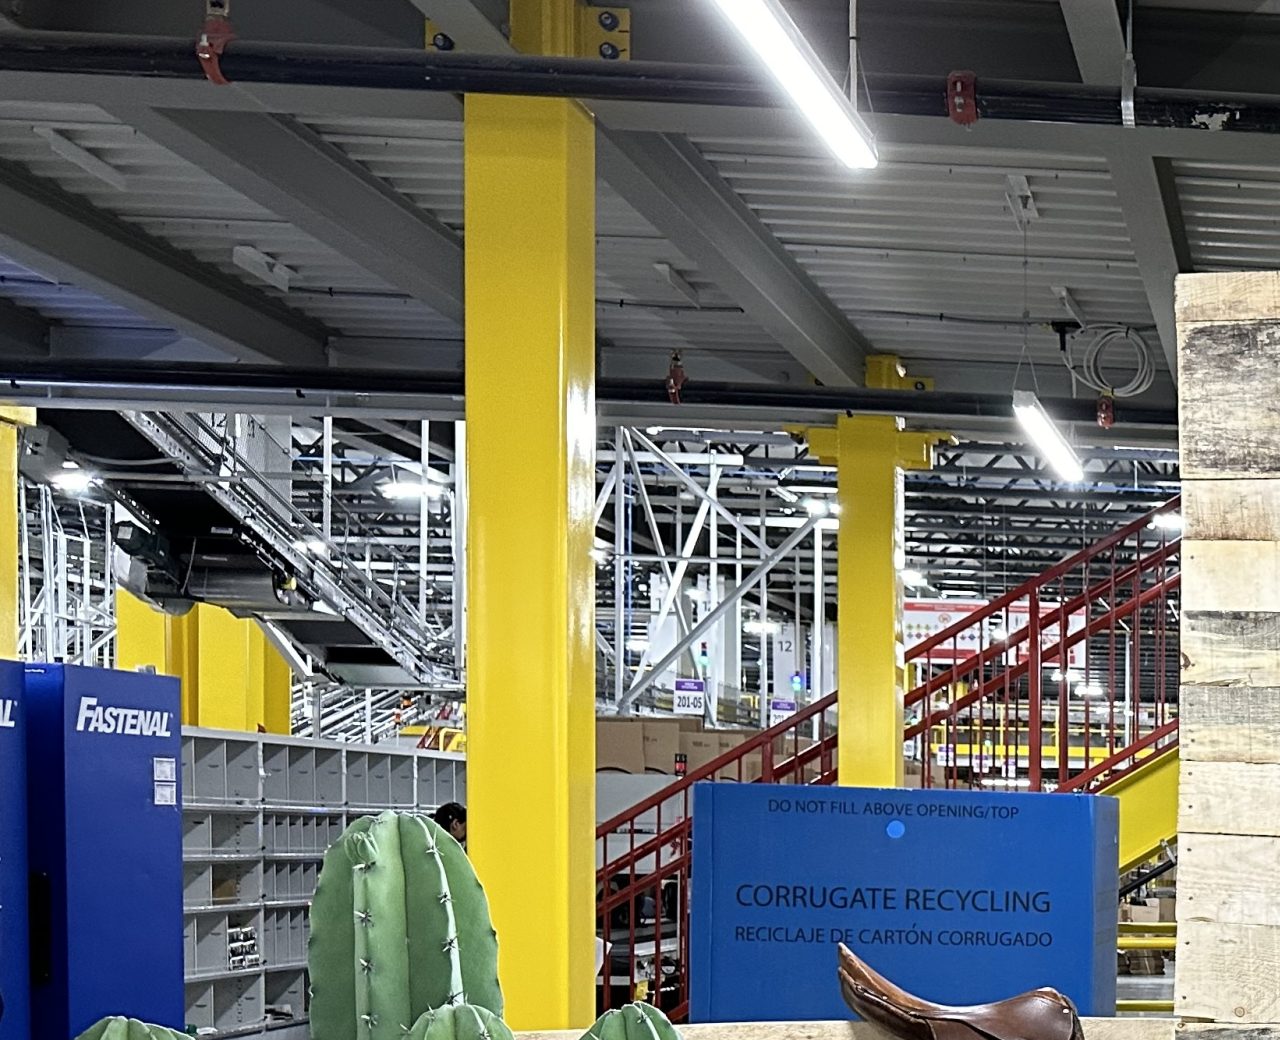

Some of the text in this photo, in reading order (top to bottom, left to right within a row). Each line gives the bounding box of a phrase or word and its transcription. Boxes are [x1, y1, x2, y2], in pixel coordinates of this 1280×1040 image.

[778, 640, 793, 653] 12
[677, 695, 703, 709] 201-05
[76, 696, 172, 738] FASTENAL
[768, 799, 1020, 820] DO NOT FILL ABOVE OPENING/TOP
[735, 883, 1051, 914] CORRUGATE RECYCLING
[735, 922, 1053, 948] RECICLAJE DE CARTÓN CORRUGADO
